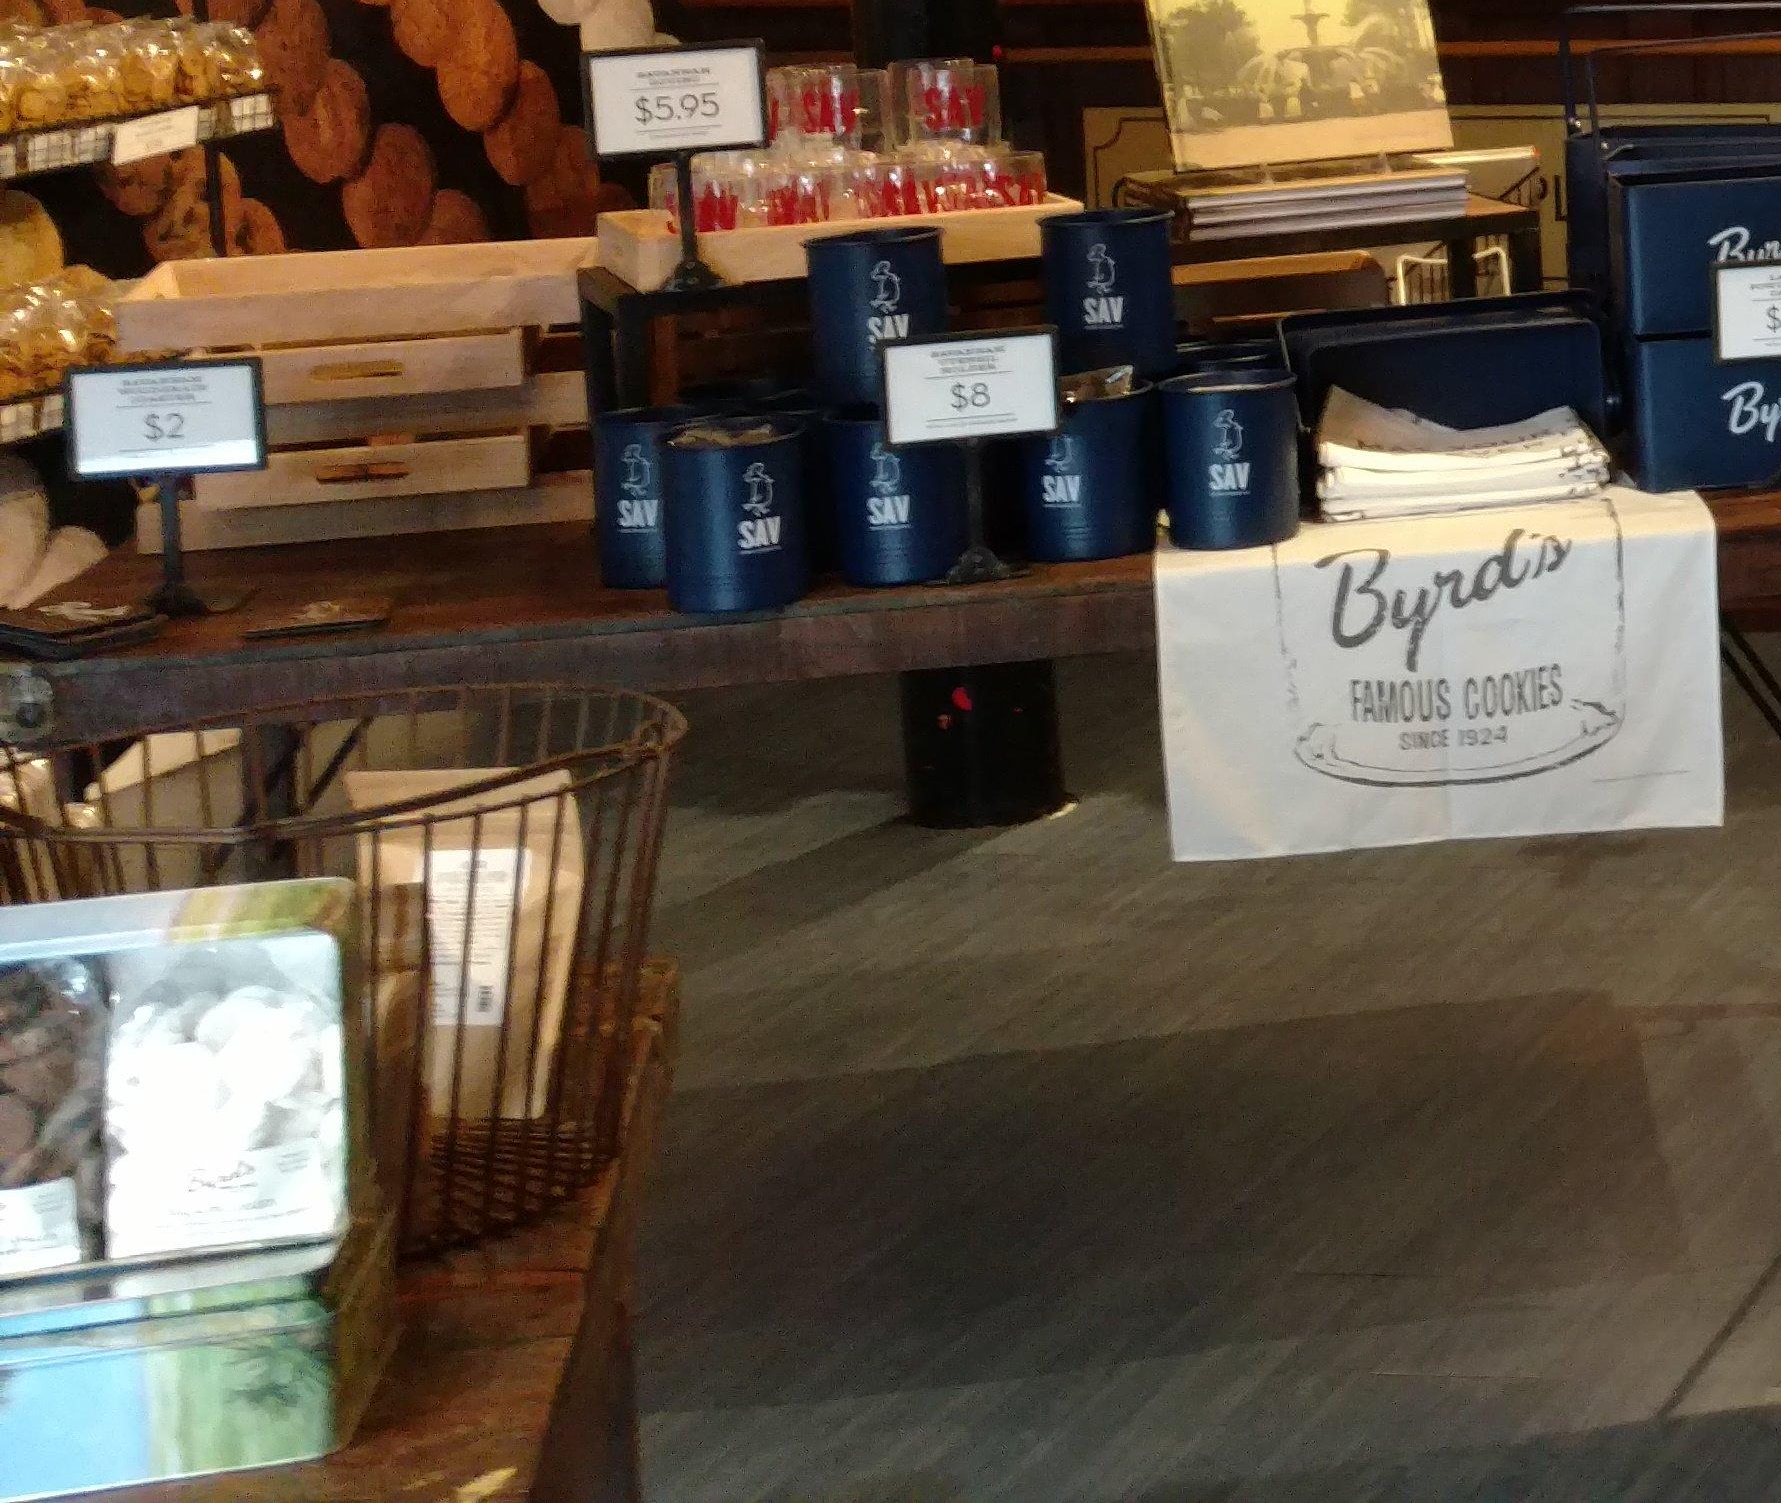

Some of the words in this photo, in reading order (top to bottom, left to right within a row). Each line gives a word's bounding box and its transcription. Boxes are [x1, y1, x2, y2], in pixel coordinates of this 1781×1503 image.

[634, 92, 721, 126] $5.95
[1082, 297, 1124, 325] SAV
[868, 314, 909, 343] SAV
[951, 382, 991, 411] $8
[143, 412, 185, 442] $2
[1041, 475, 1081, 503] SAV
[1208, 462, 1250, 490] SAV
[616, 499, 659, 528] SAV
[865, 495, 911, 526] SAV
[737, 516, 782, 548] SAV
[1314, 528, 1572, 673] Byrd's
[1351, 678, 1451, 723] FAMOUS
[1463, 662, 1564, 720] COOKIES
[1399, 729, 1448, 750] SINCE
[1457, 725, 1509, 748] 1924
